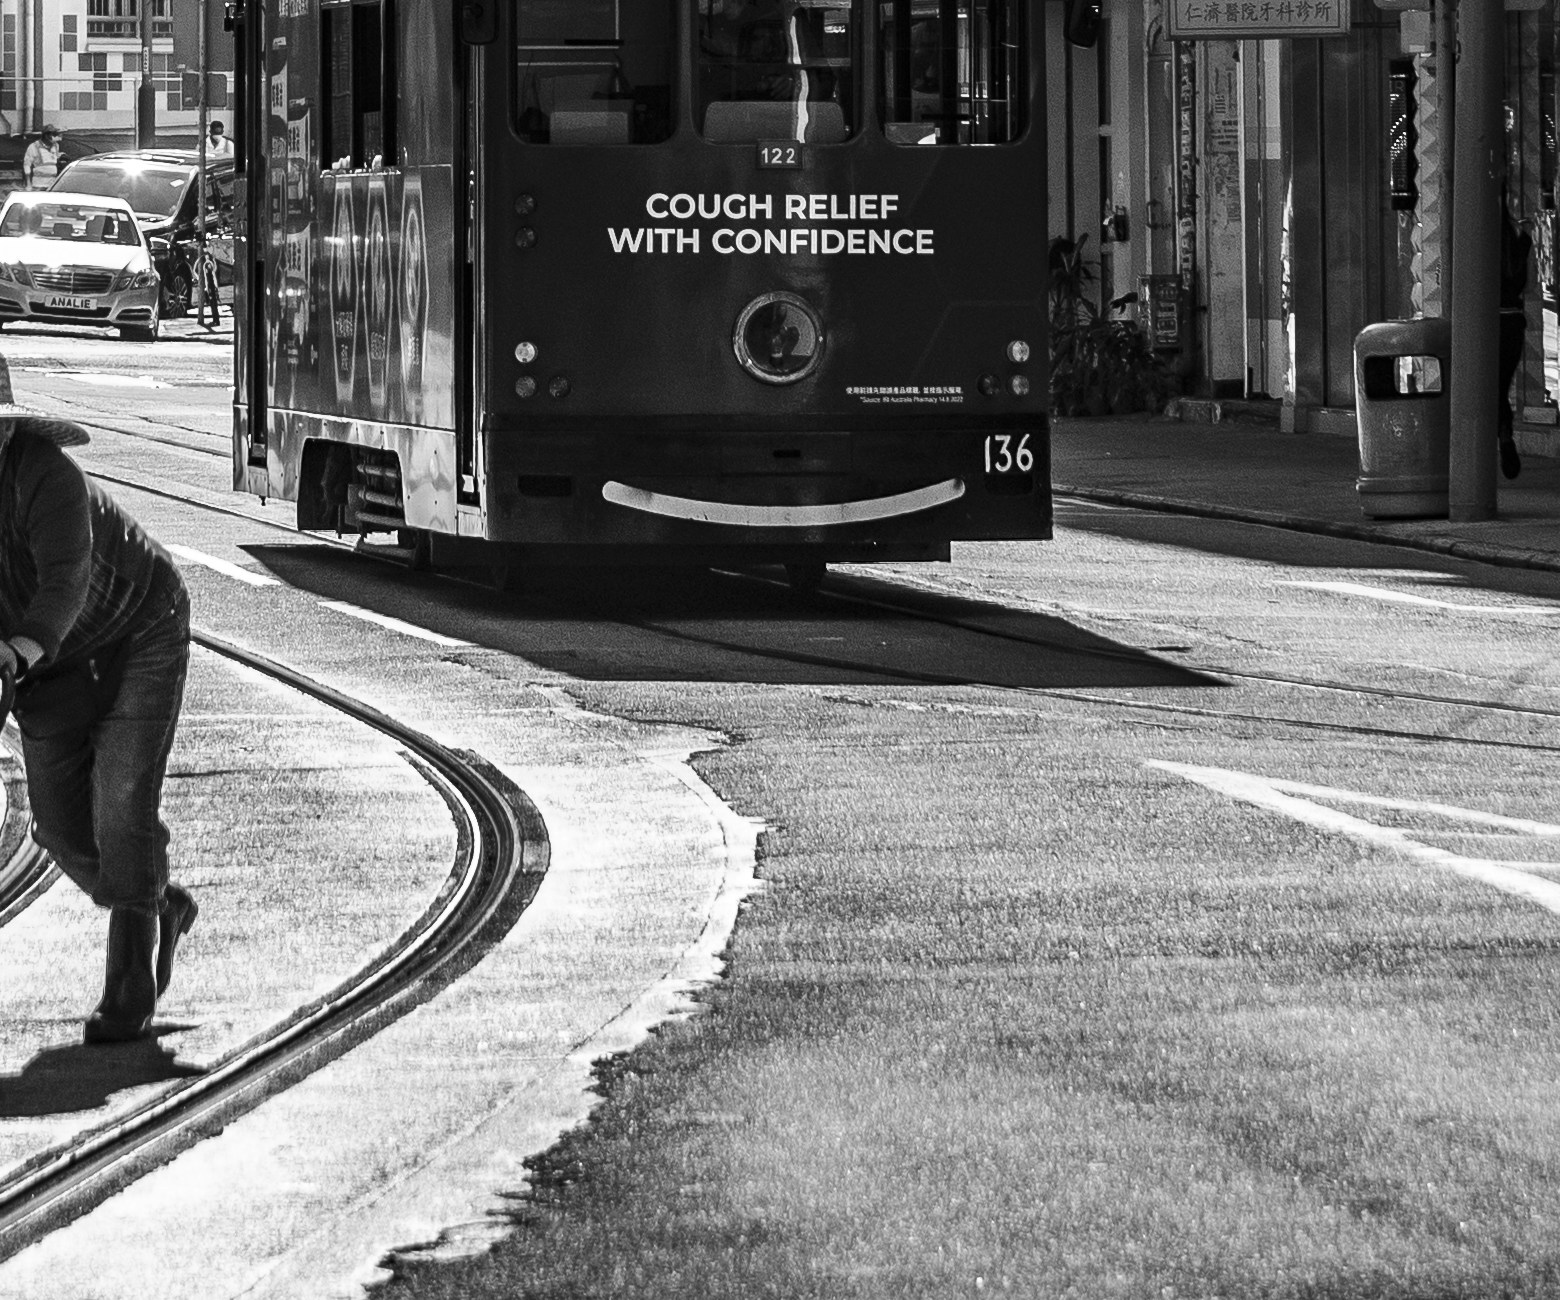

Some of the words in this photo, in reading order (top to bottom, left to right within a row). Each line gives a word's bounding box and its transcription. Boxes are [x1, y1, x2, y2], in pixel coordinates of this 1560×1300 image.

[1185, 0, 1332, 24] 仁濟醫院牙科診所
[760, 147, 796, 165] 122
[645, 192, 773, 220] COUGH
[785, 194, 899, 220] RELIEF
[607, 227, 700, 254] WITH
[711, 227, 935, 255] CONFIDENCE
[984, 433, 1034, 473] 136
